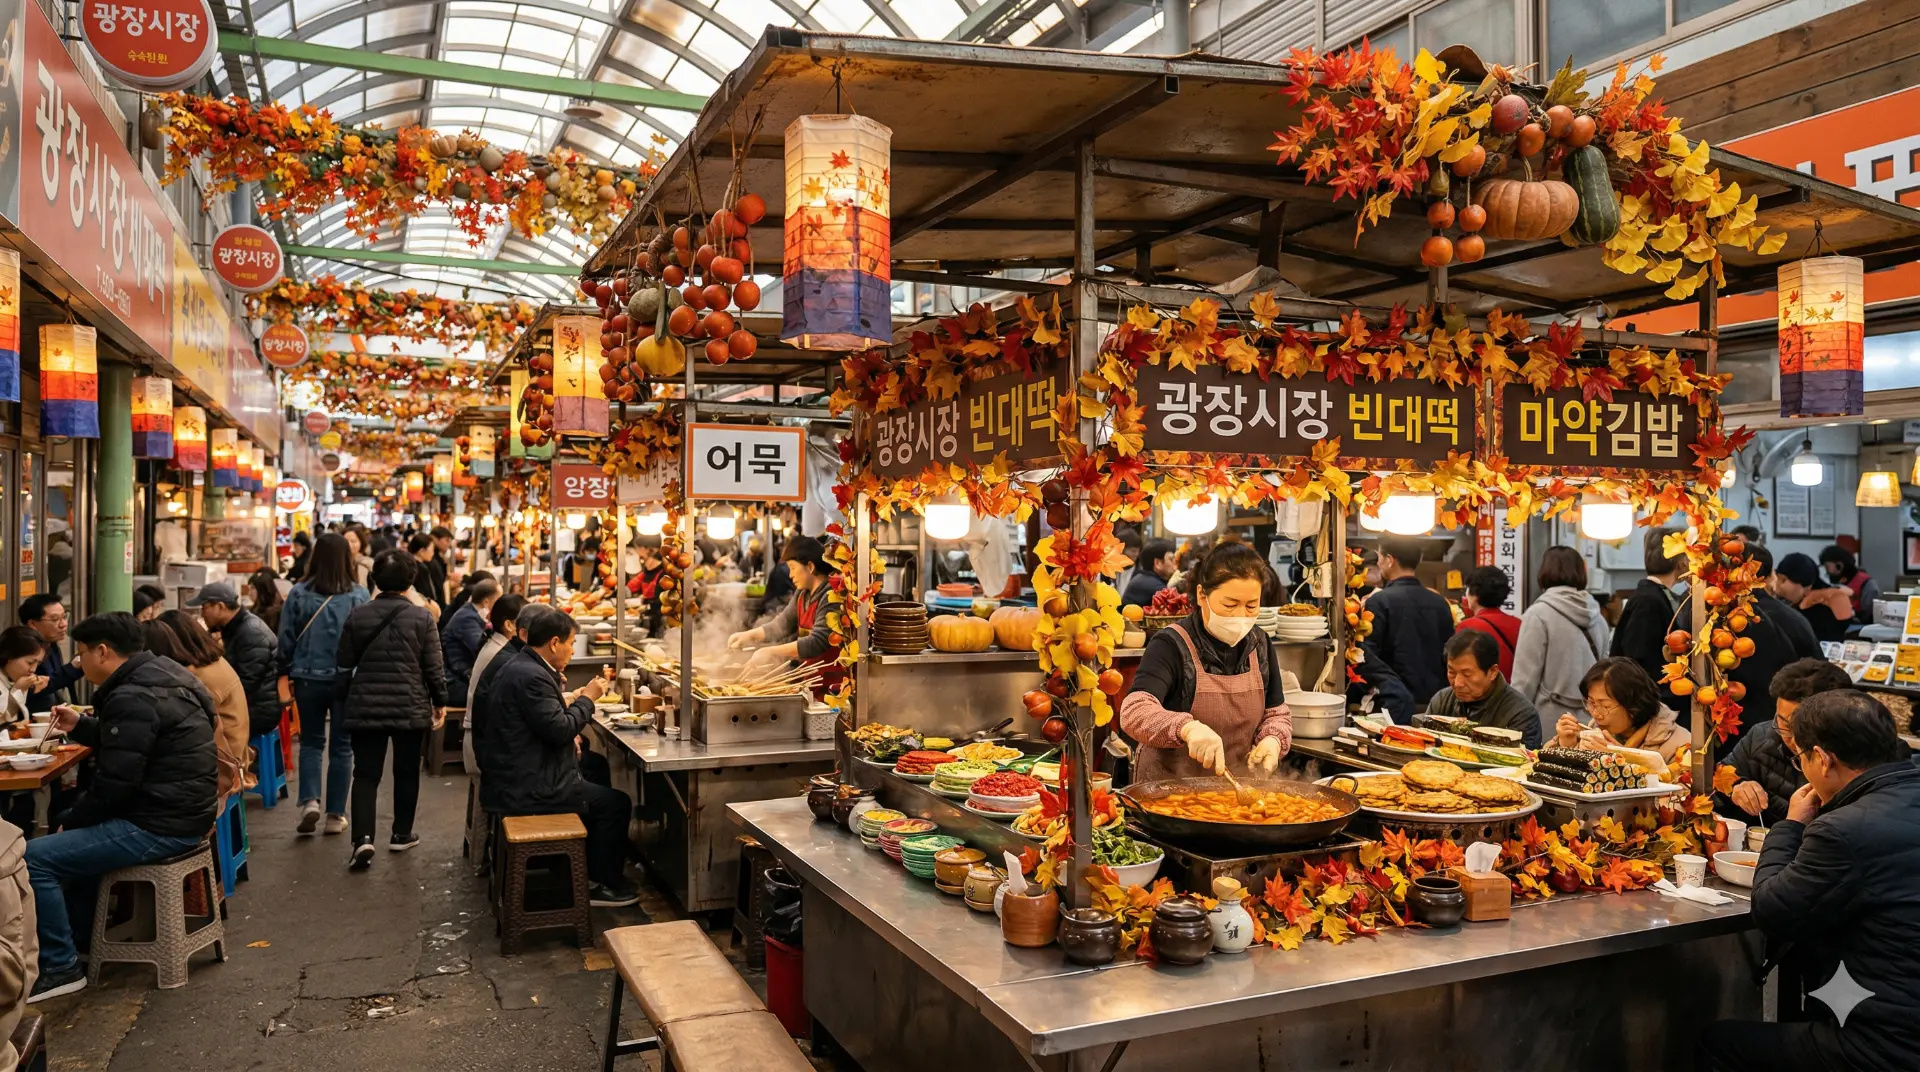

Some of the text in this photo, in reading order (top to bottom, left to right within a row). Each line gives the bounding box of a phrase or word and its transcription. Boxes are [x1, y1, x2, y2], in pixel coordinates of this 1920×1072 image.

[93, 2, 200, 43] 광장시장
[218, 247, 276, 269] 광장시장
[876, 376, 1056, 467] 광장시장 빈대떡
[1156, 382, 1459, 446] 광장시장 빈대떡
[1520, 397, 1684, 458] 마약김밥
[706, 441, 787, 485] 어묵
[564, 476, 617, 499] 앙장
